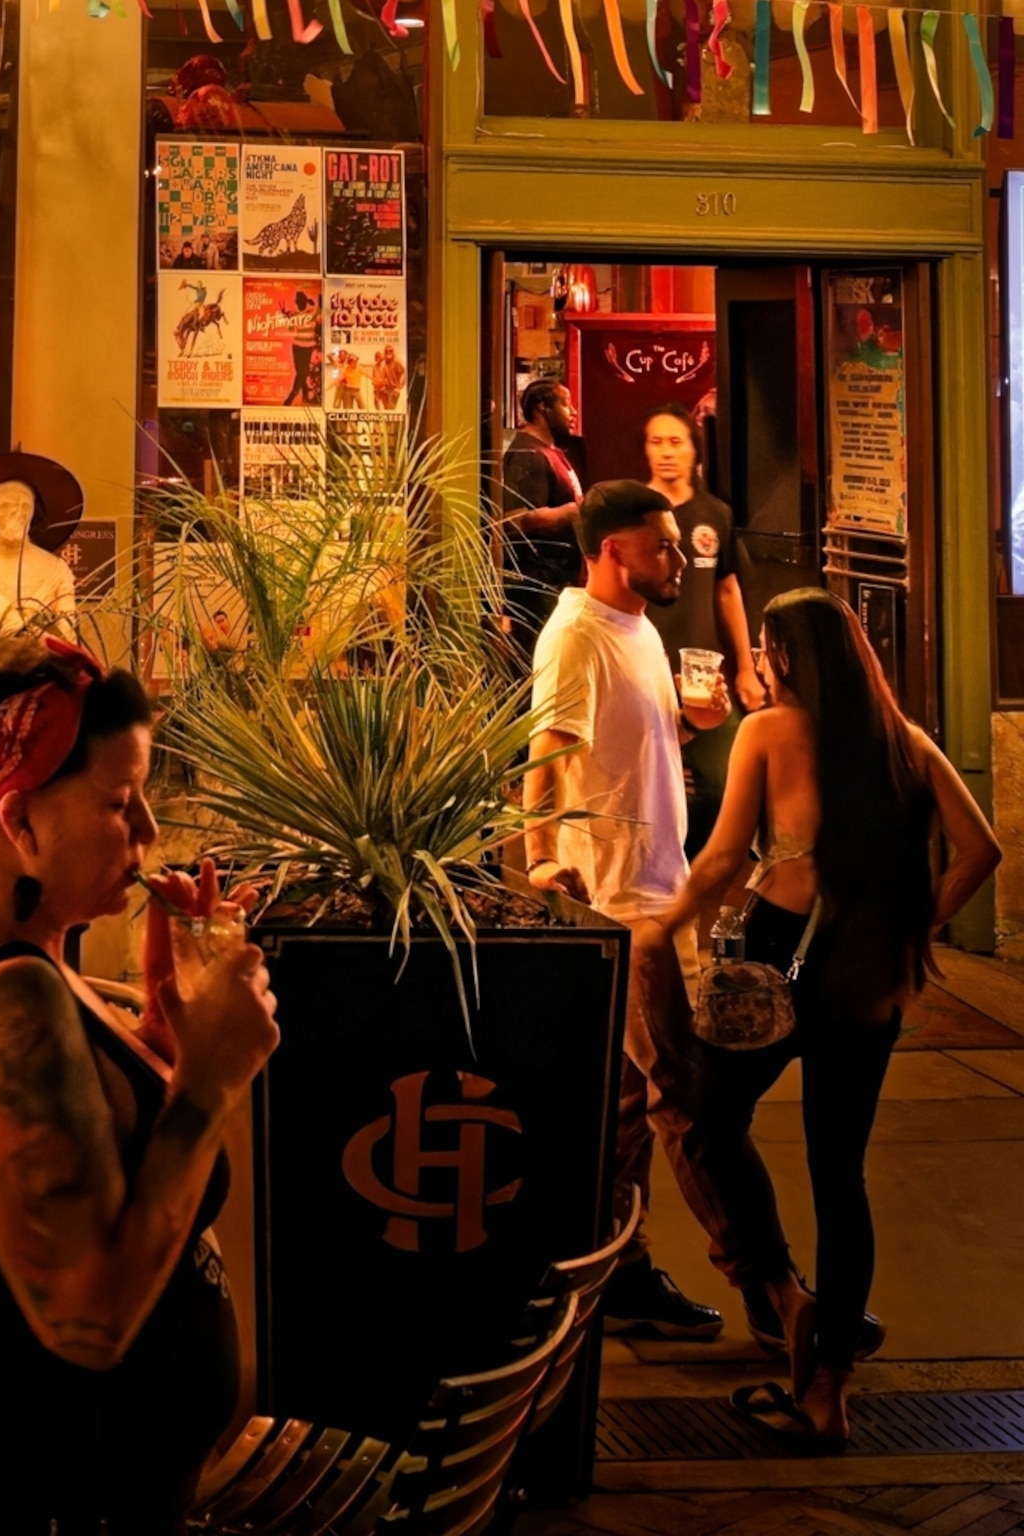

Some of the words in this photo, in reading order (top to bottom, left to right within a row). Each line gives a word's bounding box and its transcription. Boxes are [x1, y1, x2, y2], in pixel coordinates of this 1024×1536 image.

[246, 163, 298, 173] AMERICANA
[328, 153, 400, 183] GAT-ROT
[246, 171, 273, 180] NIGHT
[247, 311, 313, 336] Nightmare
[328, 413, 358, 421] CLUB
[359, 413, 404, 422] CONGRESS
